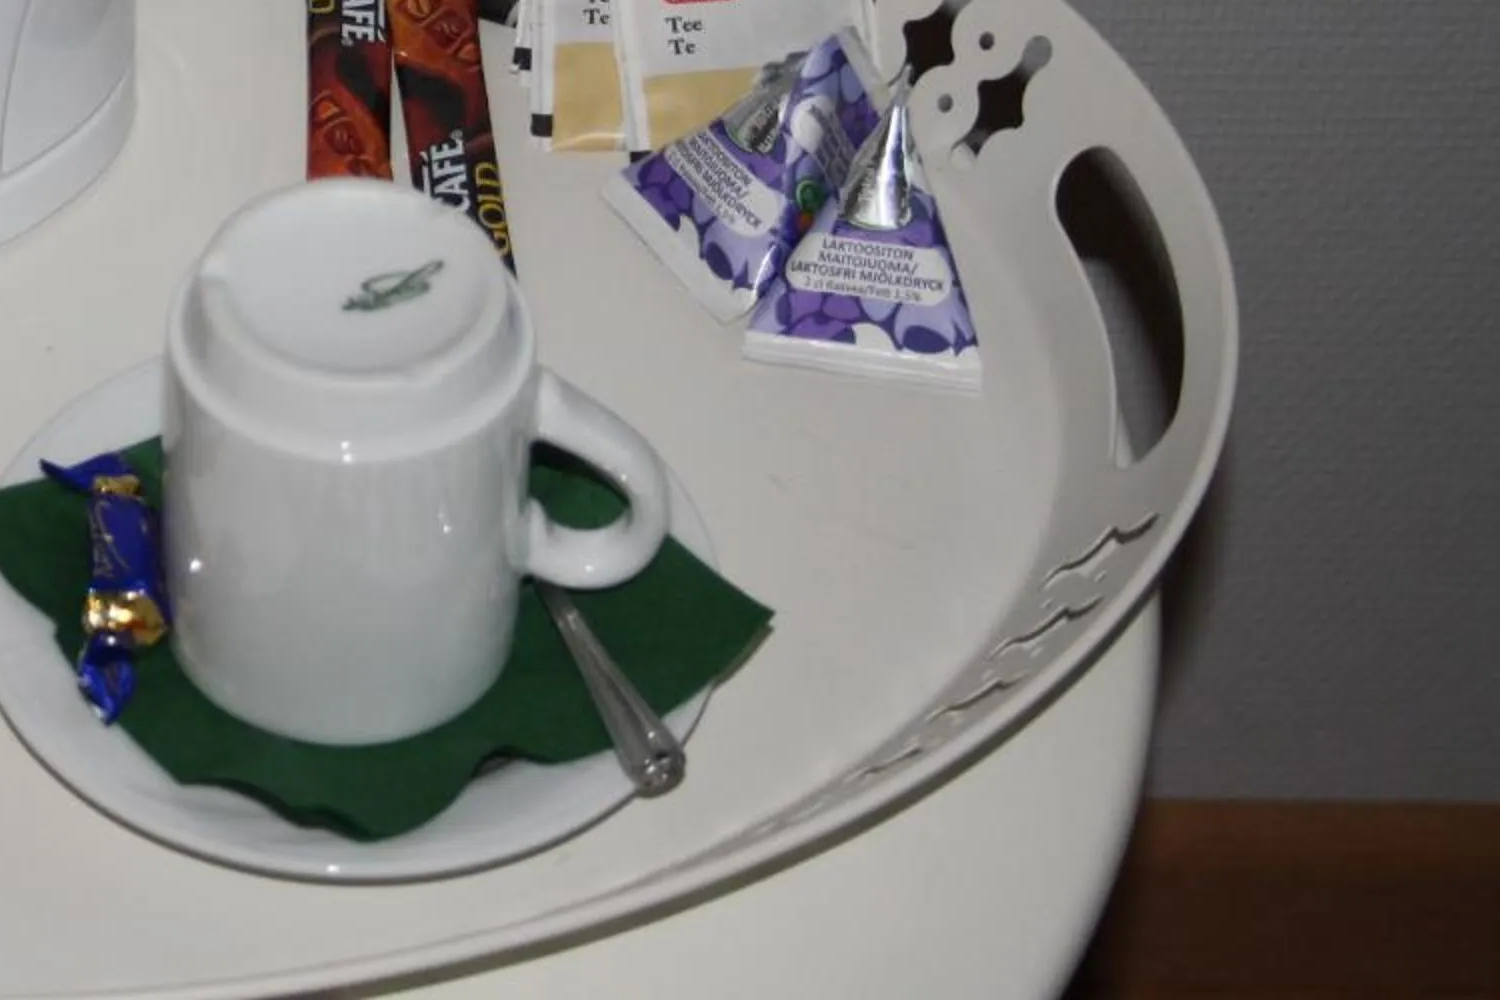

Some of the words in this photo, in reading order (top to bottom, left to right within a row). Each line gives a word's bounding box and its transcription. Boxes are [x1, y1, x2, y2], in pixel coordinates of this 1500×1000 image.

[664, 15, 703, 33] Tee
[667, 37, 696, 56] Te
[823, 238, 913, 261] LAKTOOSITON
